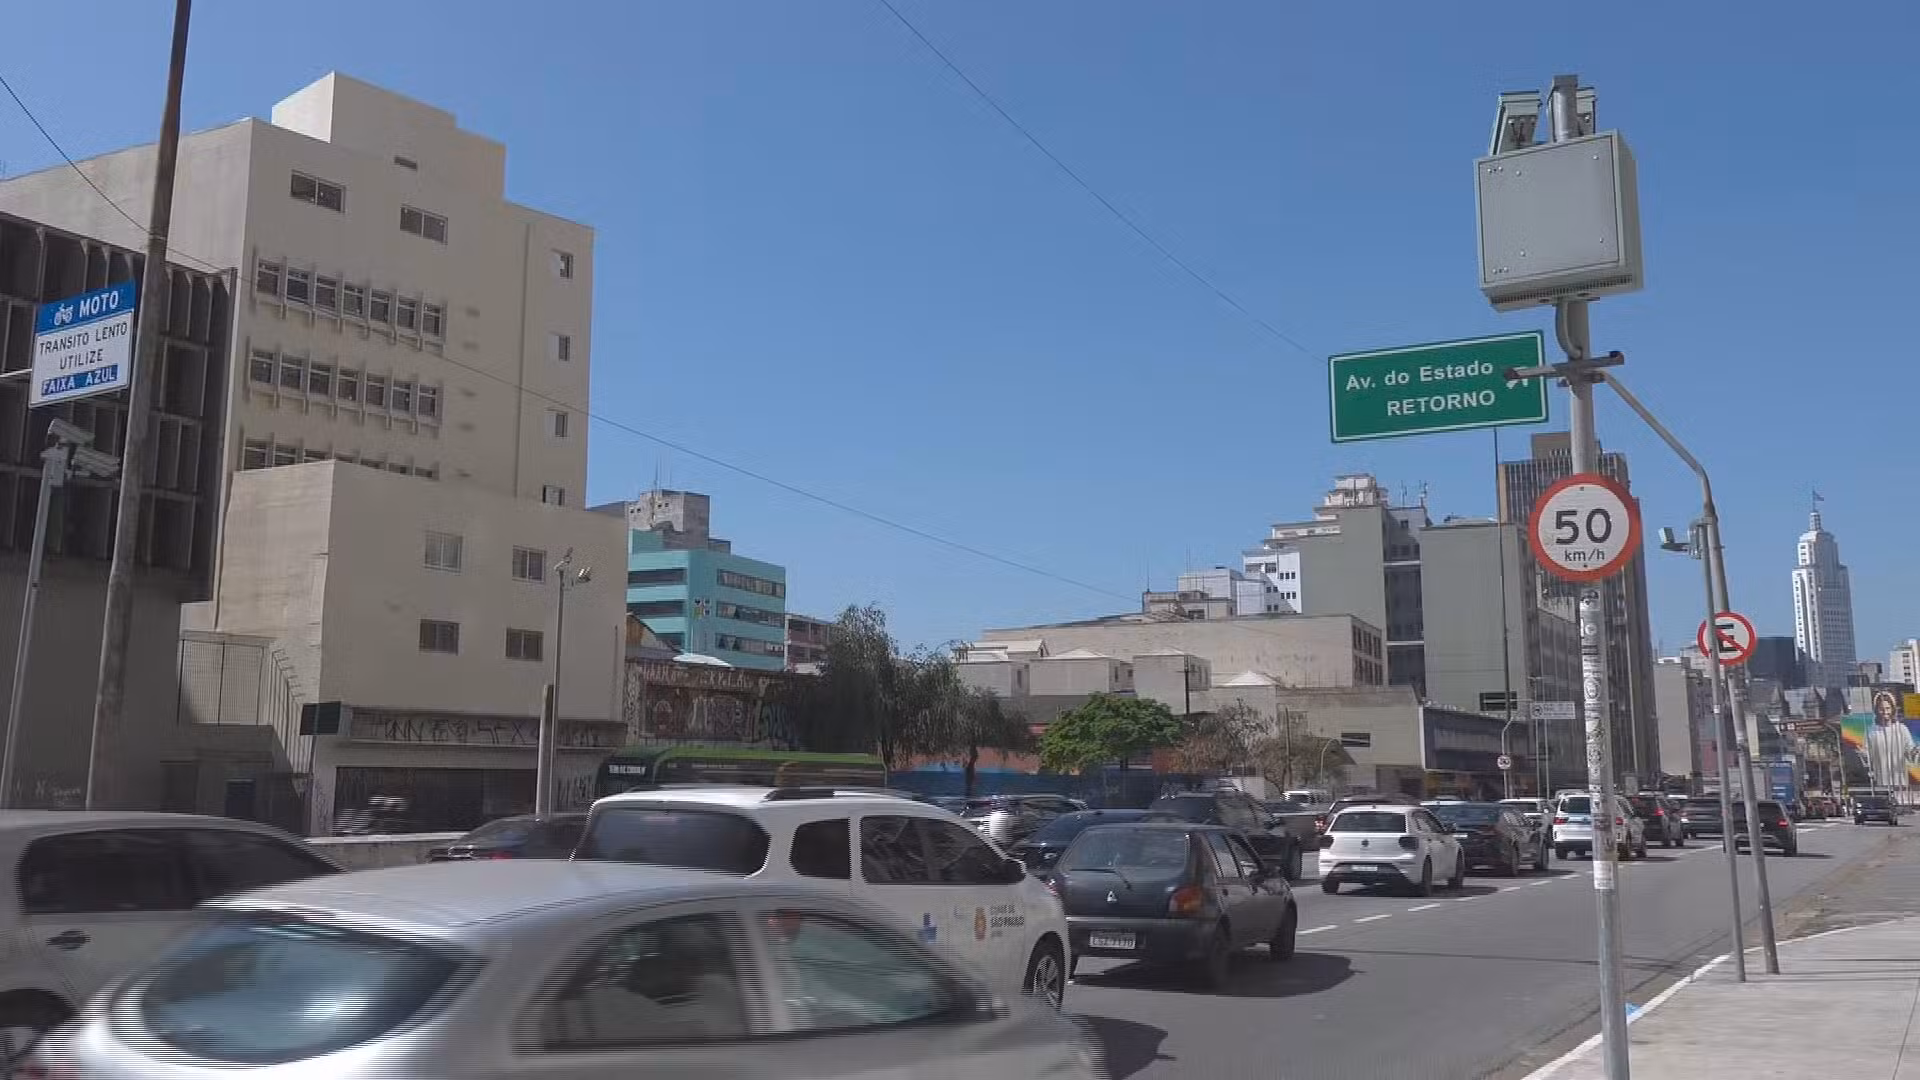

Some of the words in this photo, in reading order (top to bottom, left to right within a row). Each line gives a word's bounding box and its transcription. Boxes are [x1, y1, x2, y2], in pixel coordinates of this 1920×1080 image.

[79, 291, 119, 318] MOTO
[95, 322, 128, 342] LENTO
[59, 348, 104, 370] UTILIZE
[42, 376, 76, 394] FAIXA
[84, 367, 115, 386] AZUL
[1345, 374, 1376, 391] Av.
[1384, 370, 1410, 386] do
[1419, 360, 1493, 382] Estado
[1386, 390, 1496, 416] RETORNO
[1555, 508, 1612, 544] 50
[1564, 548, 1605, 562] km/h
[1714, 624, 1738, 653] E
